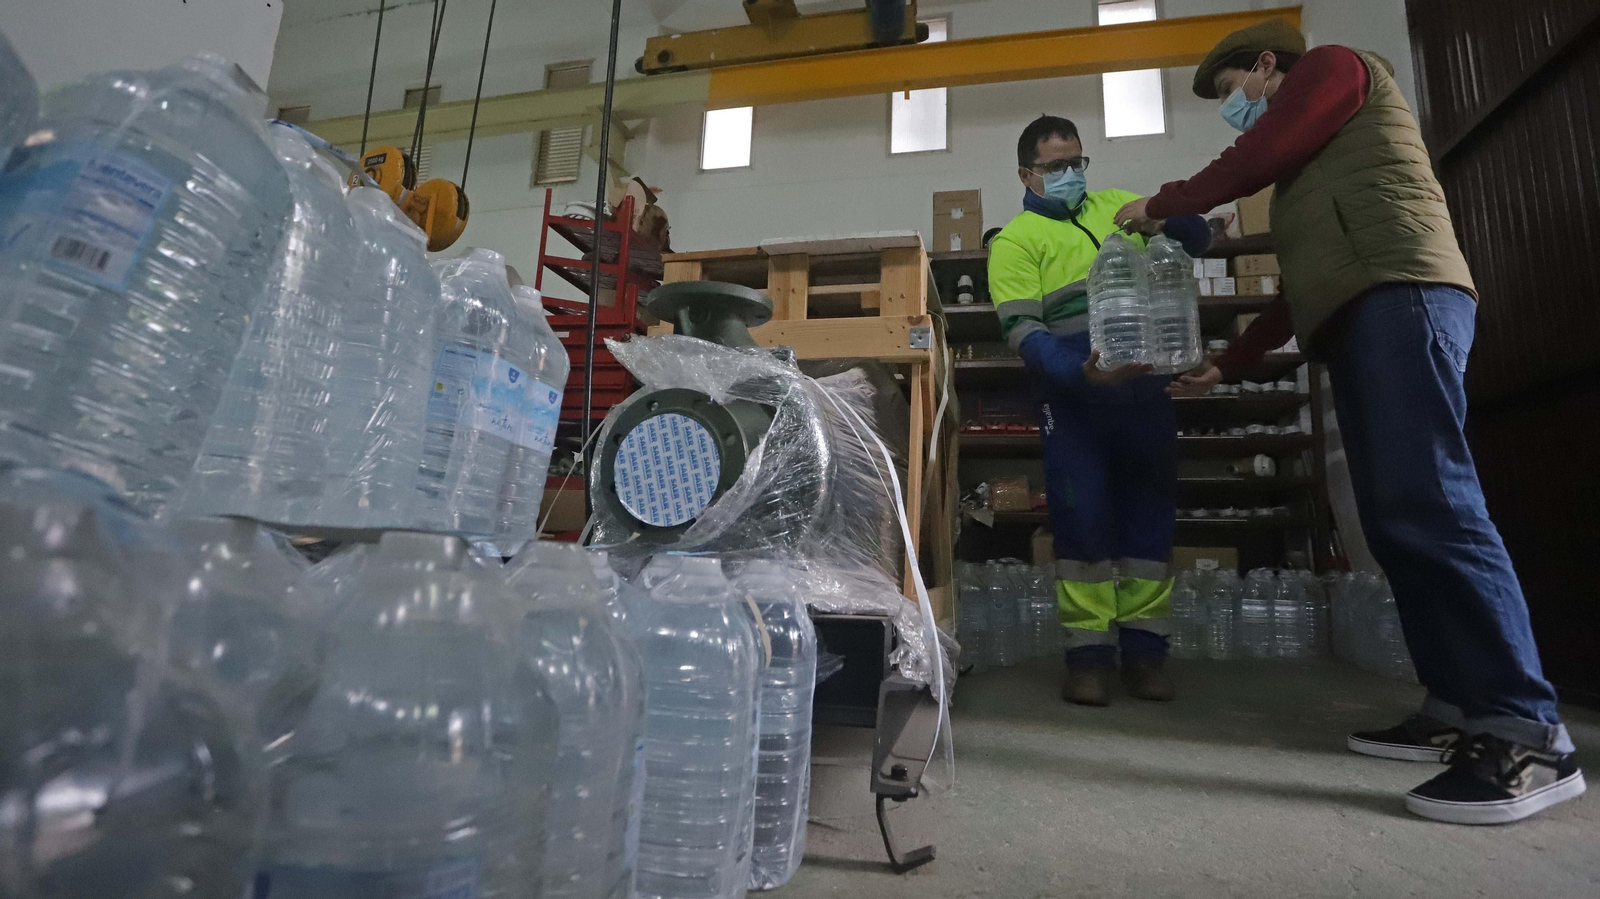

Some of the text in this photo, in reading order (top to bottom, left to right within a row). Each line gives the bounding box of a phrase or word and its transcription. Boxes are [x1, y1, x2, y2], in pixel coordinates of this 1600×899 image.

[352, 175, 358, 185] 2
[671, 416, 680, 437] SAER
[1042, 403, 1055, 430] aqualia
[648, 422, 657, 442] SAER
[662, 432, 671, 452] SAER
[684, 426, 694, 446] SAER
[639, 436, 648, 456] SAER
[652, 445, 661, 466] SAER
[675, 439, 684, 460] SAER
[699, 433, 708, 454] SAER
[704, 456, 712, 477] SAER
[630, 451, 639, 472] SAER
[644, 458, 652, 480] SAER
[666, 455, 675, 476] SAER
[690, 449, 699, 470] SAER
[621, 468, 630, 487] SAER
[657, 468, 666, 489] SAER
[680, 463, 689, 483] SAER
[694, 472, 704, 493] SAER
[634, 474, 643, 495] SAER
[647, 482, 656, 503] SAER
[670, 478, 680, 499] SAER
